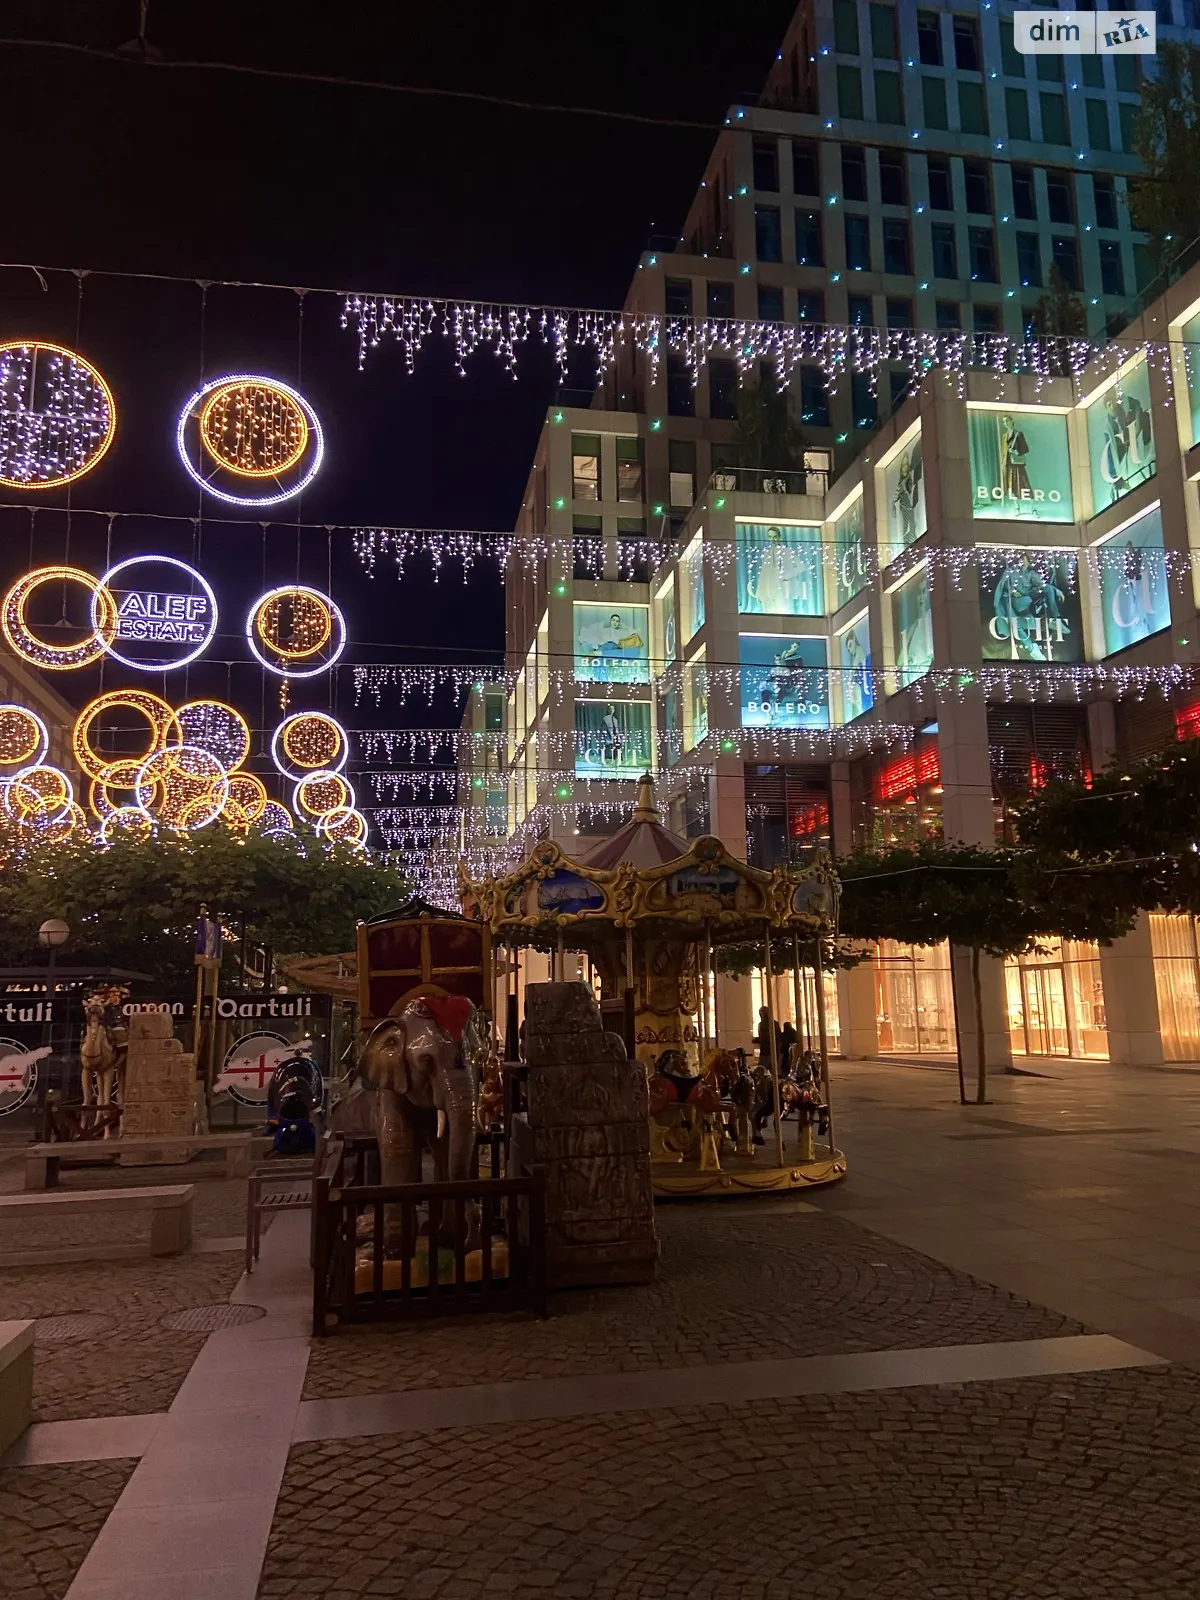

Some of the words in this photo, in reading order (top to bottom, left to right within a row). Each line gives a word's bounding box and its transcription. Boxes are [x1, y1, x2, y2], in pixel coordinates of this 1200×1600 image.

[977, 486, 1062, 503] BOLERO
[119, 592, 207, 621] ALEF
[117, 619, 205, 642] ESTATE
[989, 616, 1069, 642] CULT
[748, 702, 820, 715] BOLERO
[584, 747, 642, 767] CULT
[0, 1001, 53, 1023] tuli
[217, 997, 312, 1018] Qartuli
